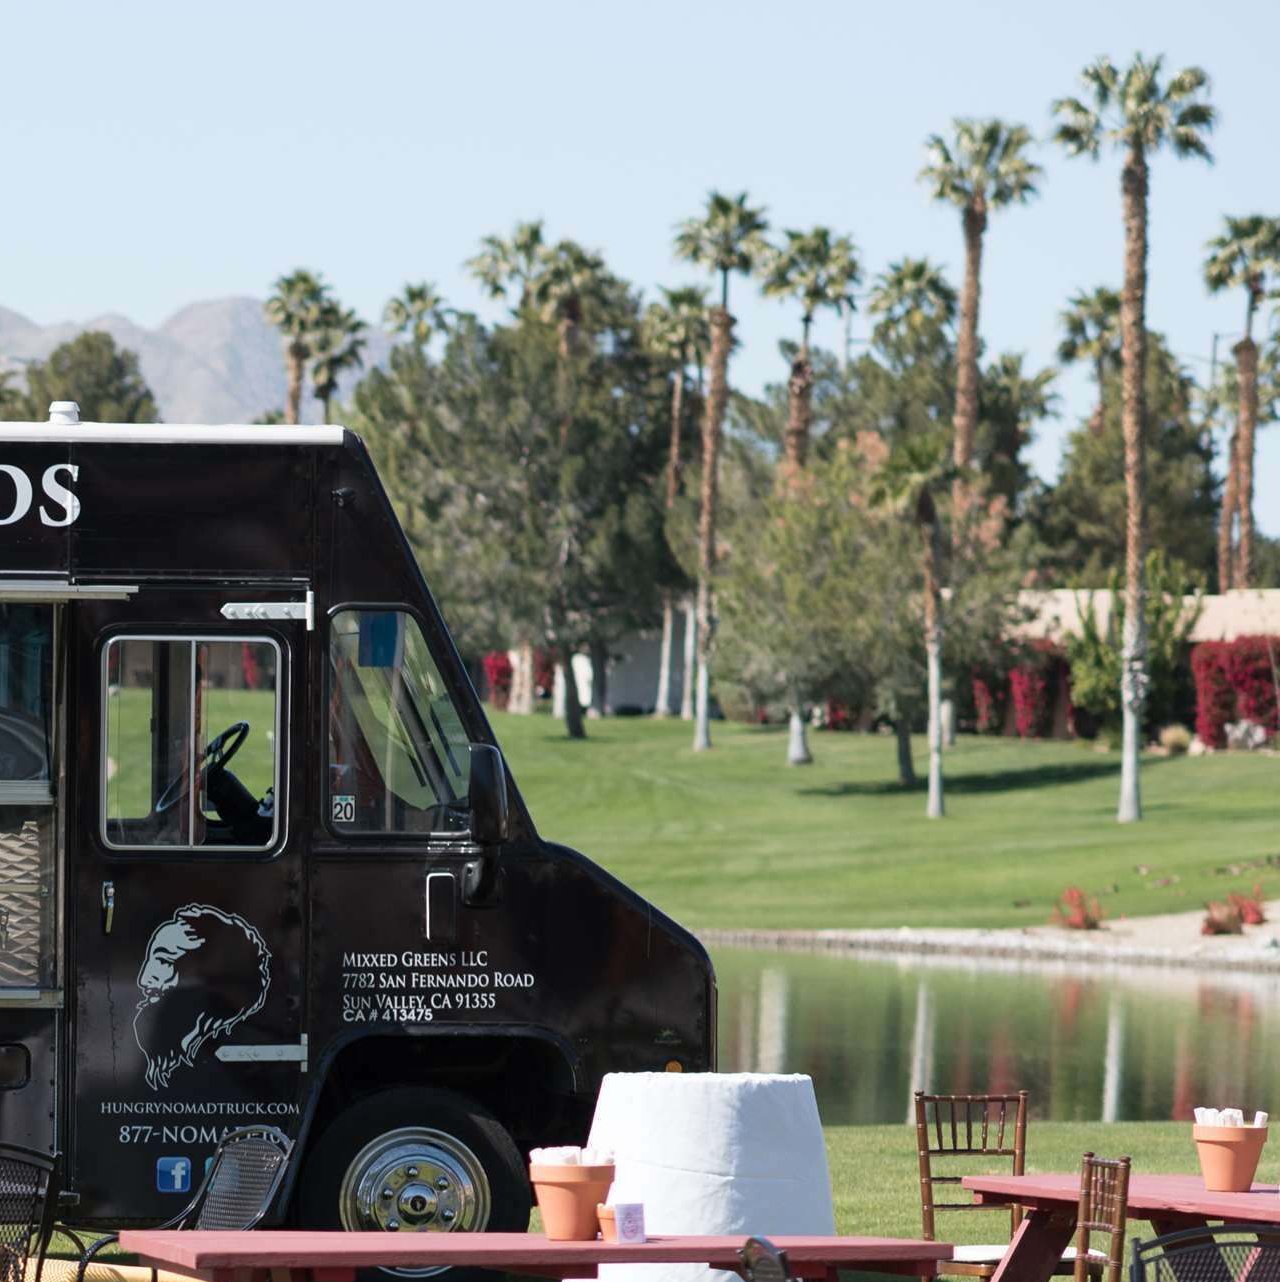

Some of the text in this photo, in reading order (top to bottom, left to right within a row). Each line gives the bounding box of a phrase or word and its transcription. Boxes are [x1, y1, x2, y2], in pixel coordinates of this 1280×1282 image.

[334, 802, 354, 821] 20
[342, 951, 488, 967] MIXXED GREENS LLC
[343, 971, 535, 988] 7782 SAN FERNANDO ROAD
[343, 993, 496, 1010] SUN VALLEY, CA 91355
[343, 1008, 433, 1021] CA # 413475
[100, 1102, 300, 1115] HUNGRYNOMADTRUCK.COM
